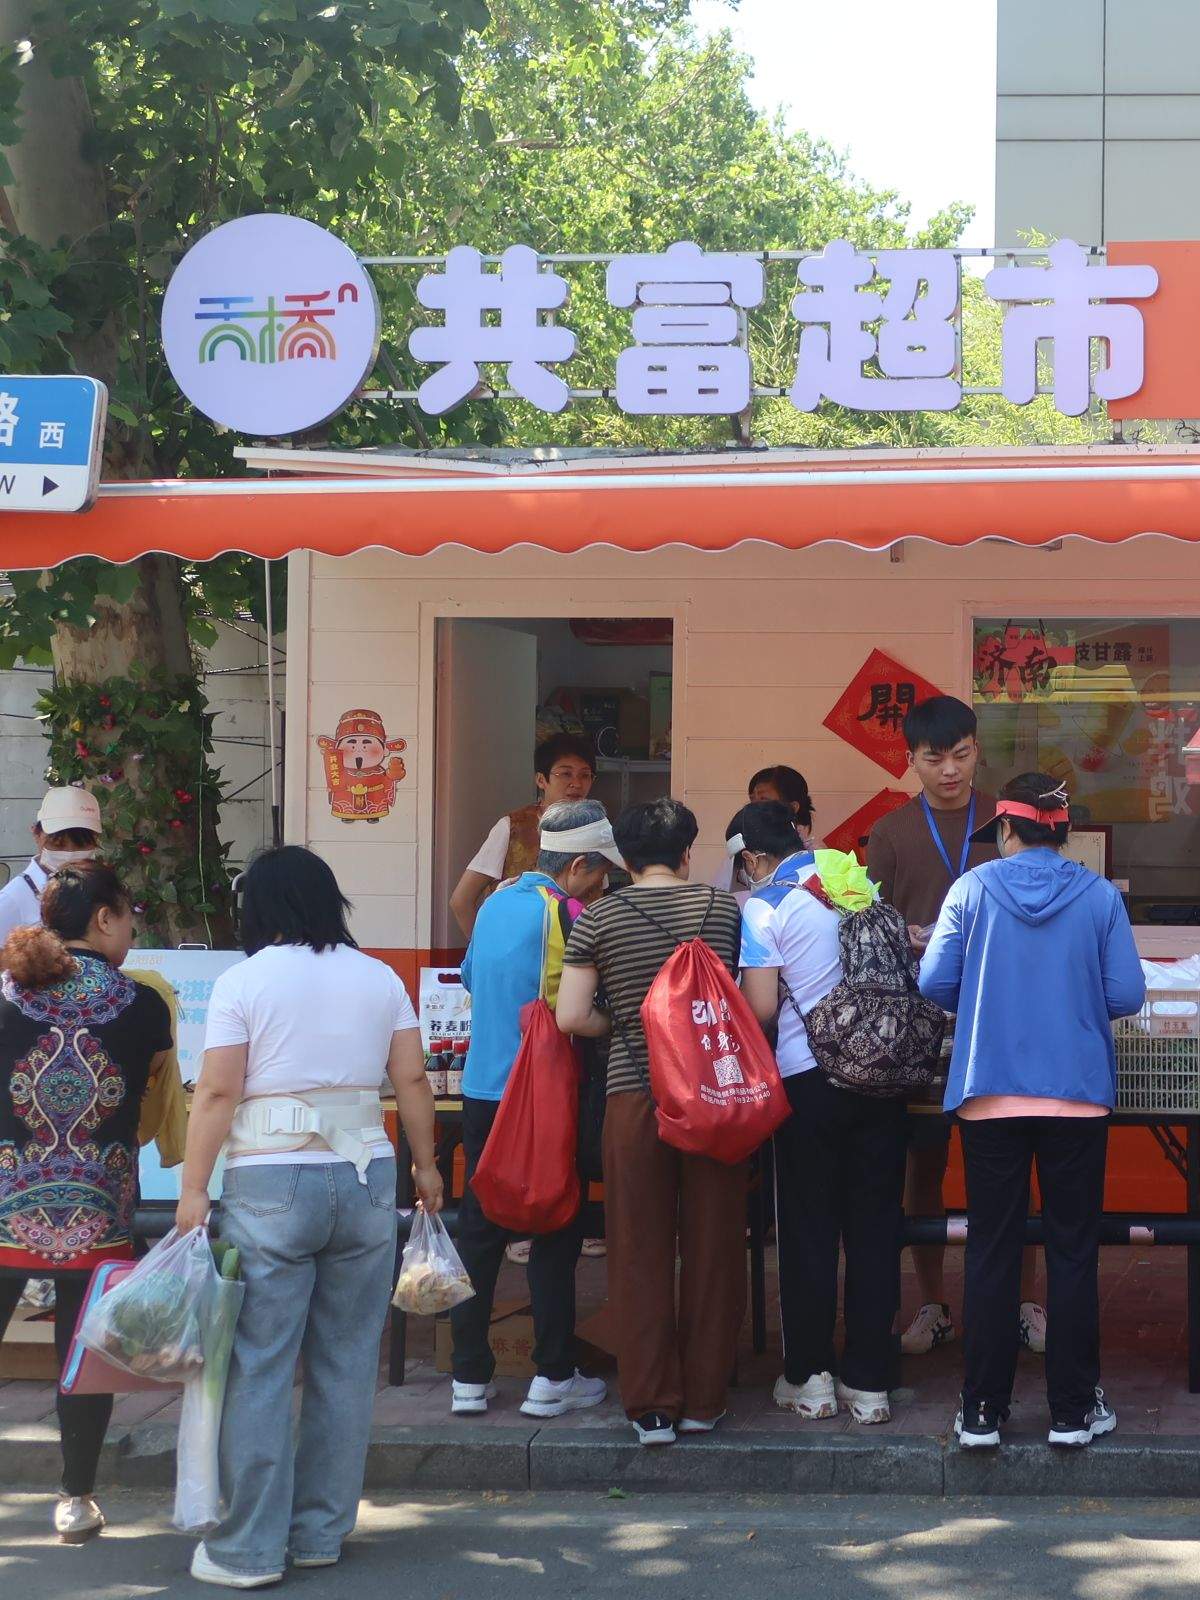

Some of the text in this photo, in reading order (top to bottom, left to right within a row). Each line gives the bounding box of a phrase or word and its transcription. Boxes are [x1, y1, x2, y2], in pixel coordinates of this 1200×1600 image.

[408, 238, 1159, 416] 共富超市
[39, 421, 66, 449] 西
[857, 682, 915, 733] 開
